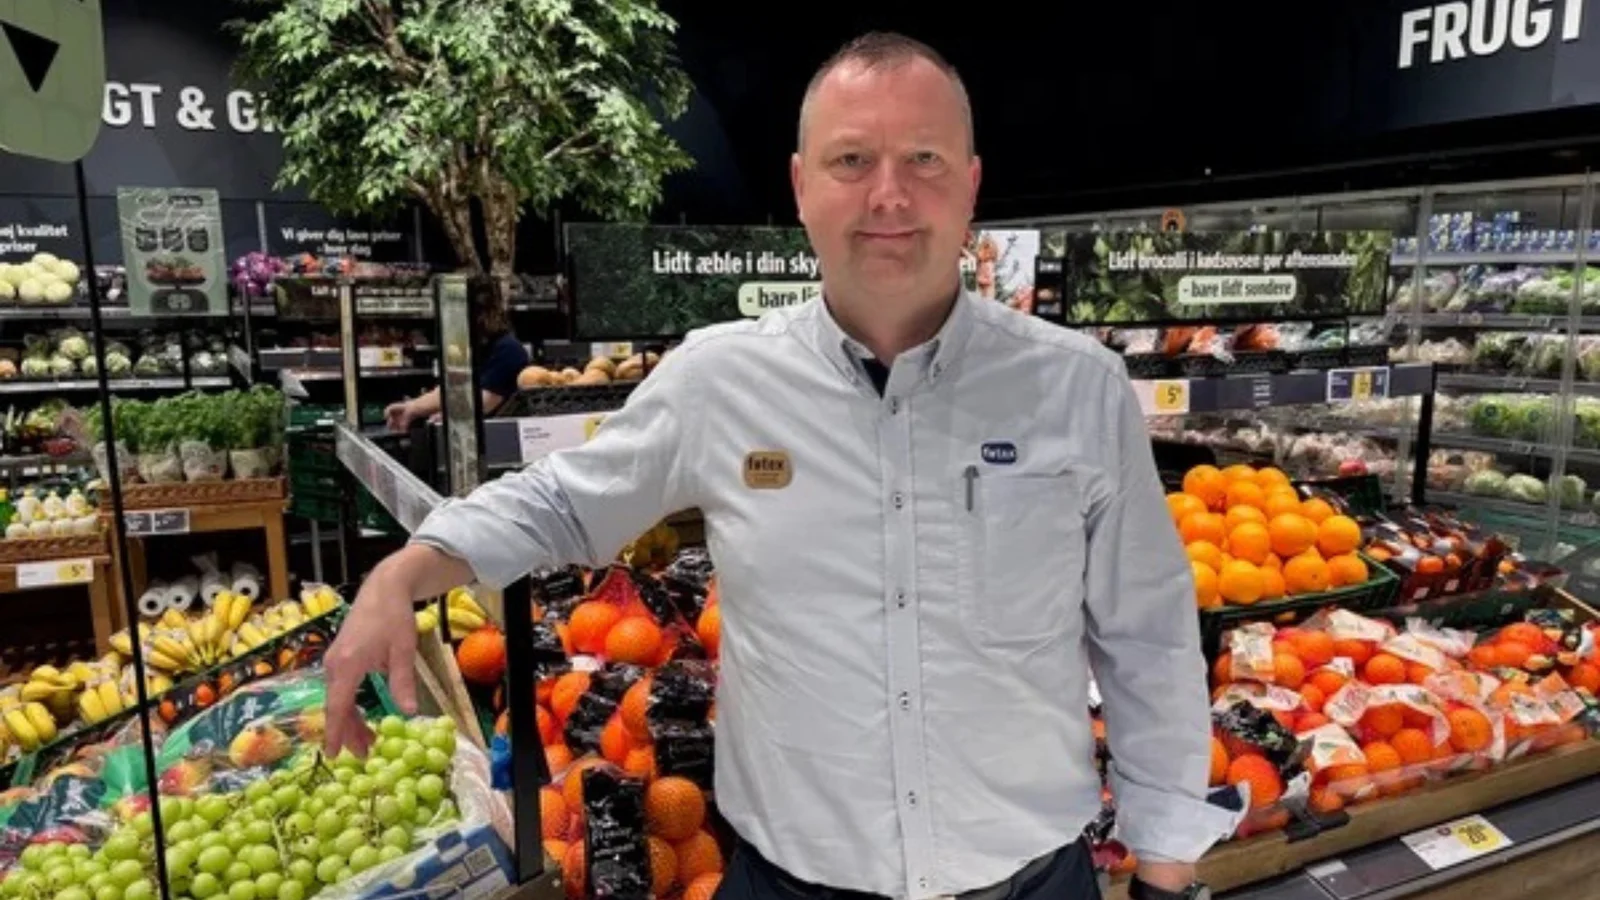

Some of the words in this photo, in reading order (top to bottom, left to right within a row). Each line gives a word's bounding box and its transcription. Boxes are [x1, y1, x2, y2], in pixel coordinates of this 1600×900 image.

[1398, 0, 1583, 68] FRUGT
[102, 82, 162, 127] GT
[176, 86, 216, 130] &
[16, 223, 68, 238] kvalitet
[653, 251, 692, 274] Lidt
[695, 251, 743, 274] æble
[746, 251, 753, 273] i
[757, 251, 785, 274] din
[1108, 250, 1137, 269] Lidt
[758, 287, 798, 309] bare
[802, 286, 819, 304] li
[1191, 279, 1219, 298] bare
